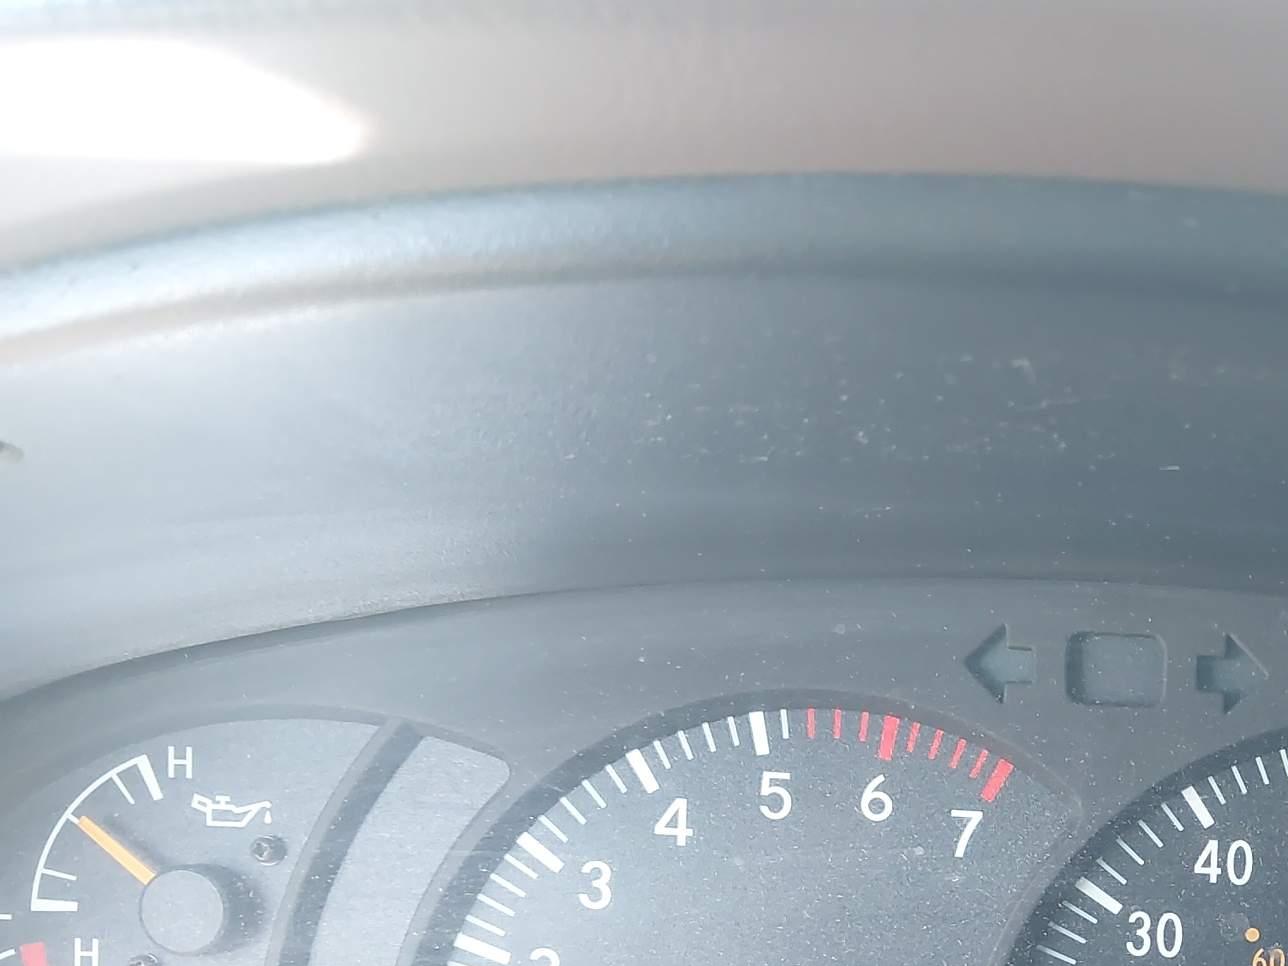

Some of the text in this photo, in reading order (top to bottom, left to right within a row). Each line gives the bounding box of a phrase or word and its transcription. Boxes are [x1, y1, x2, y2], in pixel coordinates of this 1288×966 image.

[167, 746, 194, 779] H
[759, 771, 793, 820] 5
[859, 774, 895, 822] 6
[654, 798, 694, 847] 4
[950, 809, 984, 858] 7
[577, 861, 614, 911] 3
[1194, 840, 1254, 887] 40
[1125, 912, 1183, 959] 30
